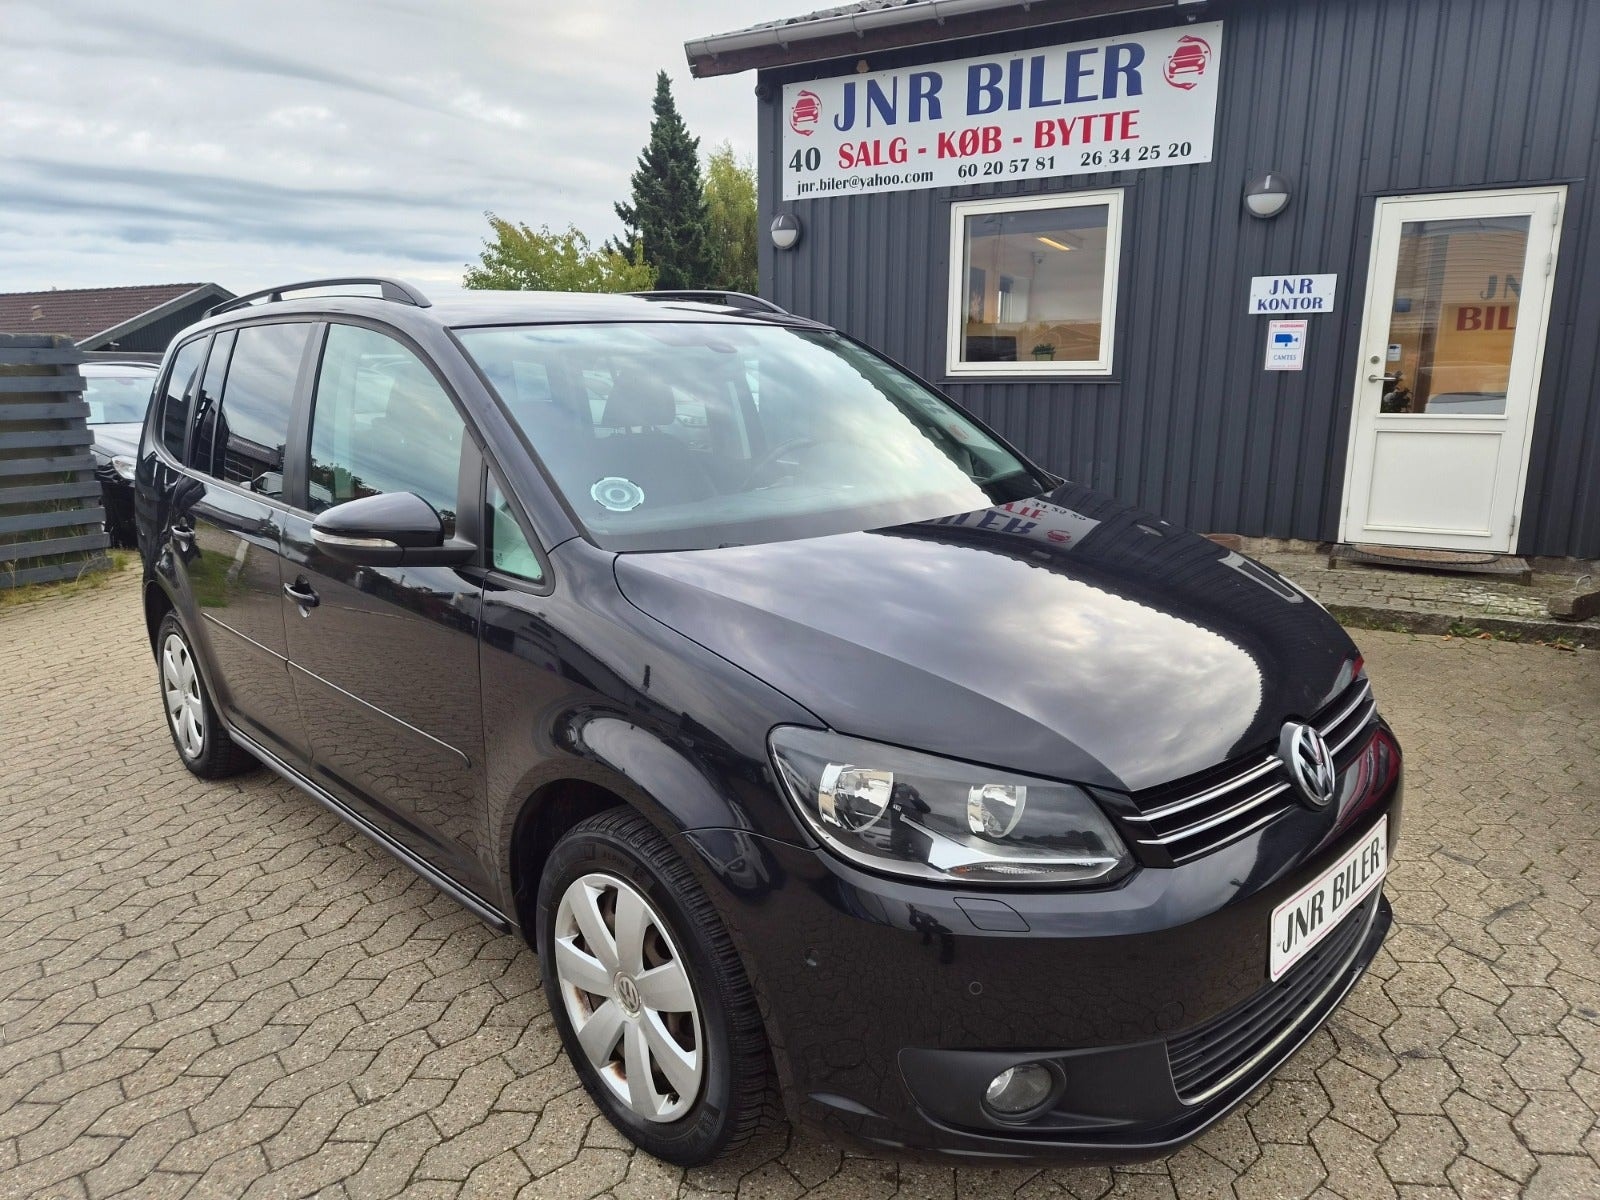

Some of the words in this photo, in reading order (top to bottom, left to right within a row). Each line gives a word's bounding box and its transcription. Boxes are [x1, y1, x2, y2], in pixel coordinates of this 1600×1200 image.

[834, 71, 943, 132] JNR
[966, 42, 1146, 116] BILER
[838, 137, 908, 170] SALG
[937, 125, 1003, 159] KØB
[1034, 109, 1141, 149] BYTTE
[788, 146, 821, 173] 40
[957, 163, 979, 179] 60
[983, 161, 1004, 177] 20
[1008, 158, 1030, 175] 57
[1034, 155, 1056, 172] 81
[1080, 151, 1103, 168] 26
[1108, 148, 1131, 165] 34
[1138, 145, 1162, 162] 25
[1168, 141, 1193, 158] 20
[796, 168, 934, 197] jnr.biler@yahoo.com
[1268, 278, 1314, 295] JNR
[1257, 297, 1324, 311] KONTOR
[1282, 890, 1325, 954] JNR
[1332, 836, 1380, 913] BILER
